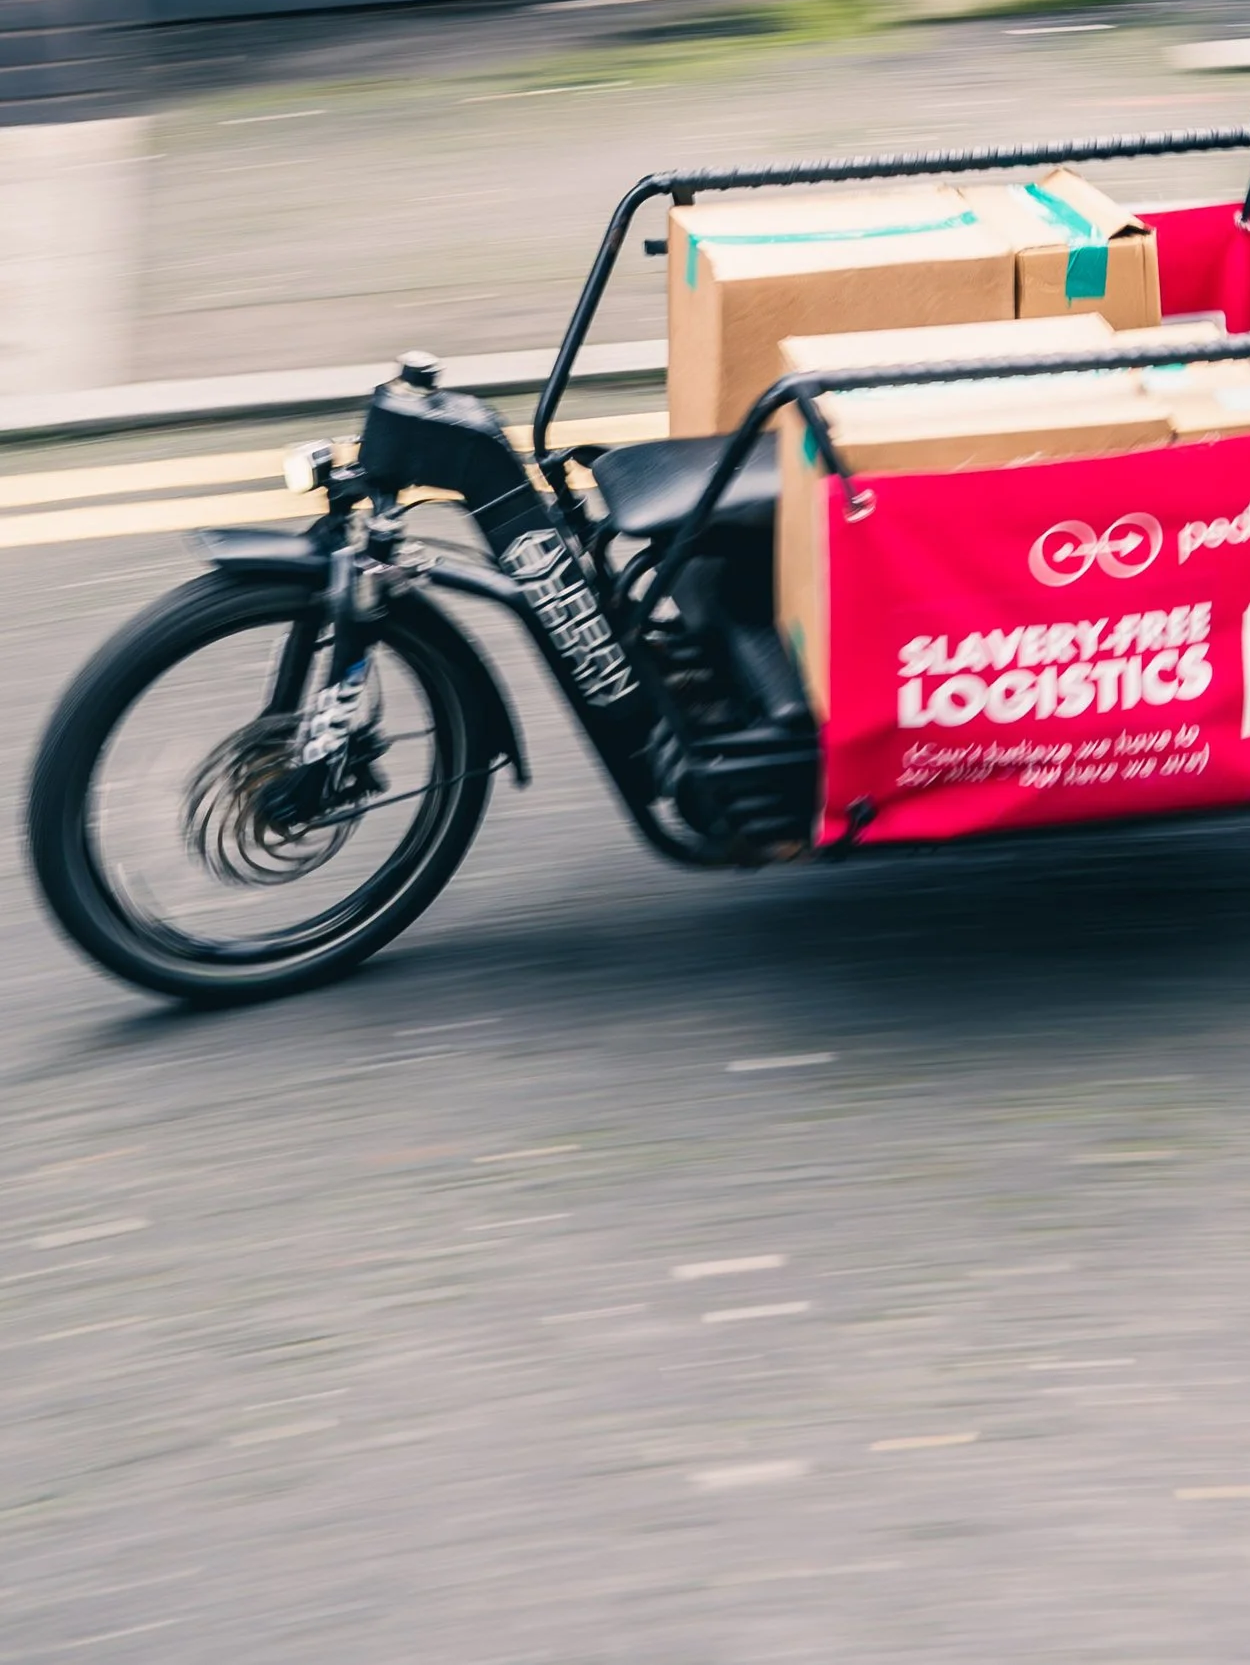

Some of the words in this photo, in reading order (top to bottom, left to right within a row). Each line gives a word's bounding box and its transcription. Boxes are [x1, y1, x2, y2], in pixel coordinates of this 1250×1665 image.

[896, 600, 1213, 677] SLAVERY-FREE
[896, 642, 1214, 729] LOGISTICS
[1174, 722, 1201, 750] to
